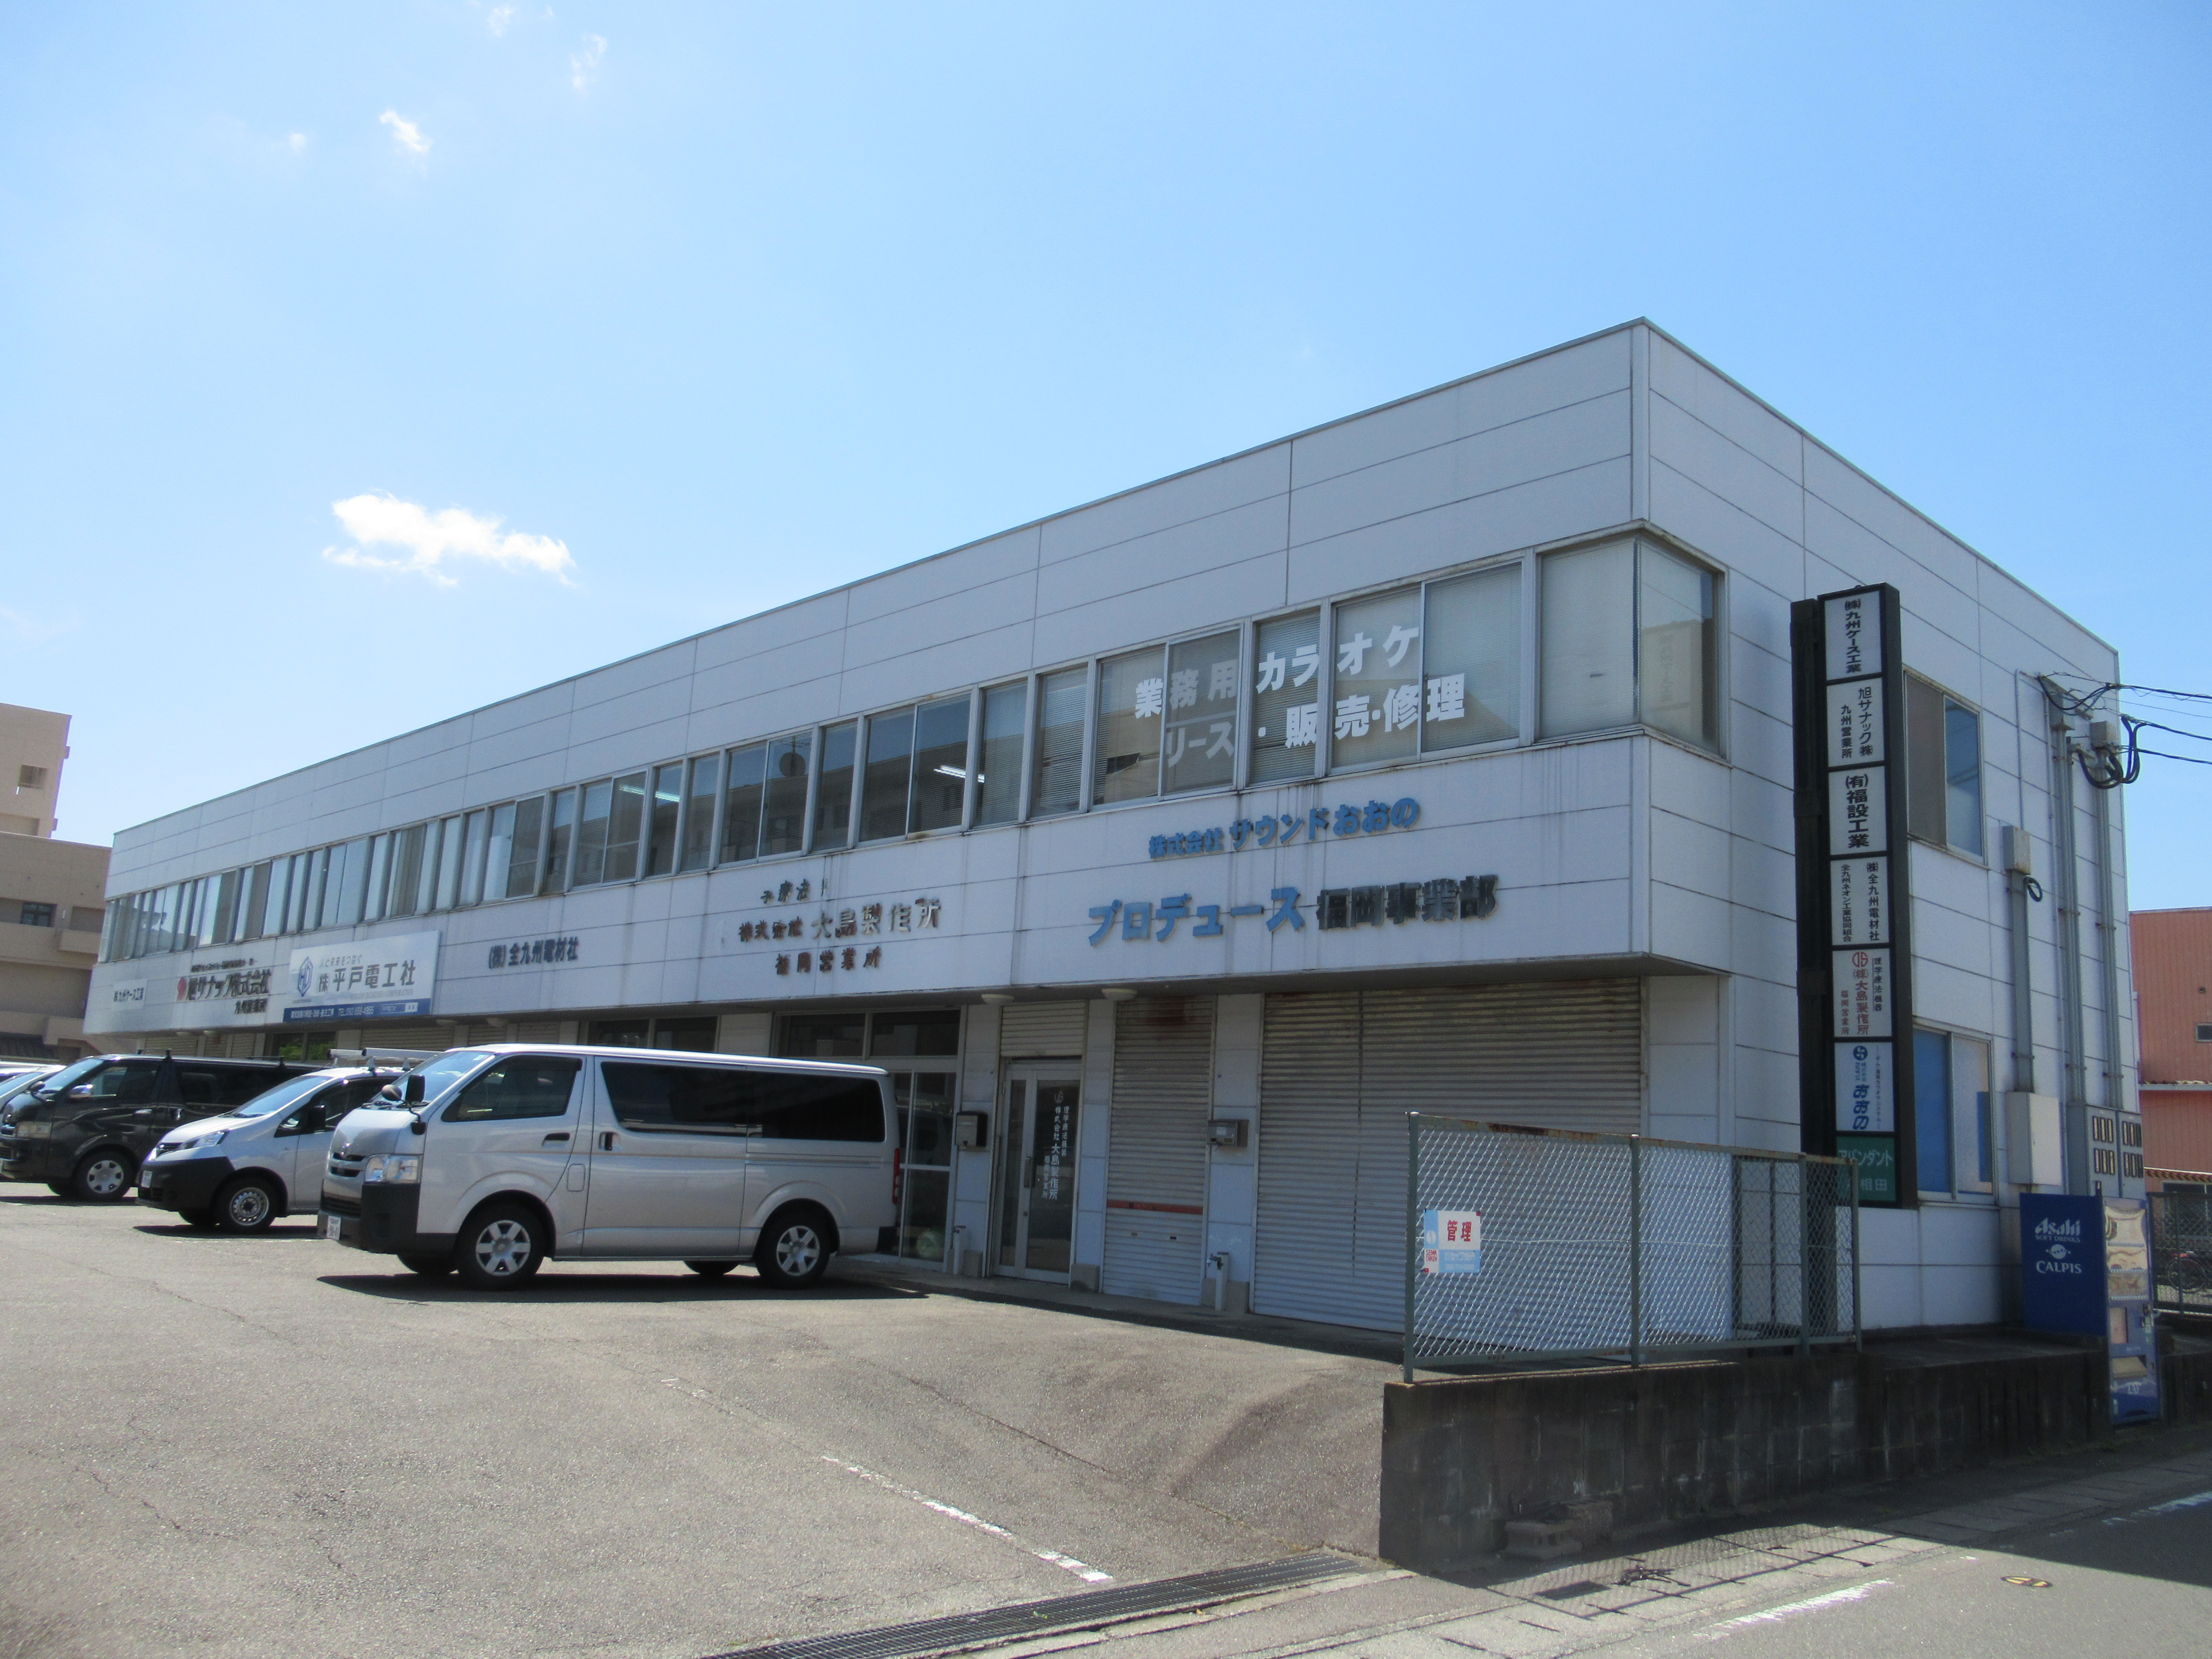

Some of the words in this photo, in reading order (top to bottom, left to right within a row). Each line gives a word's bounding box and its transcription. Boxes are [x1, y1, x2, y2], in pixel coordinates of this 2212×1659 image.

[1845, 599, 1861, 674] (株)九州ケース工業
[1135, 625, 1419, 719] 業務用カラオケ
[1841, 704, 1852, 759] 九州営業所
[1858, 686, 1873, 756] 旭サナック(株)
[1845, 774, 1869, 848] (有)福設工業
[1841, 864, 1852, 942] 全九州ネオン工業協同組合
[1866, 862, 1880, 941] (株)全九州電材社
[318, 959, 416, 992] (株)平戸電工社
[1853, 969, 1869, 1035] (株)大島製作所
[1841, 990, 1849, 1034] 福岡営業所
[1853, 1084, 1870, 1130] おおの
[1447, 1220, 1472, 1241] 管理
[2035, 1218, 2080, 1236] Asahi
[2036, 1261, 2081, 1273] CALPIS
